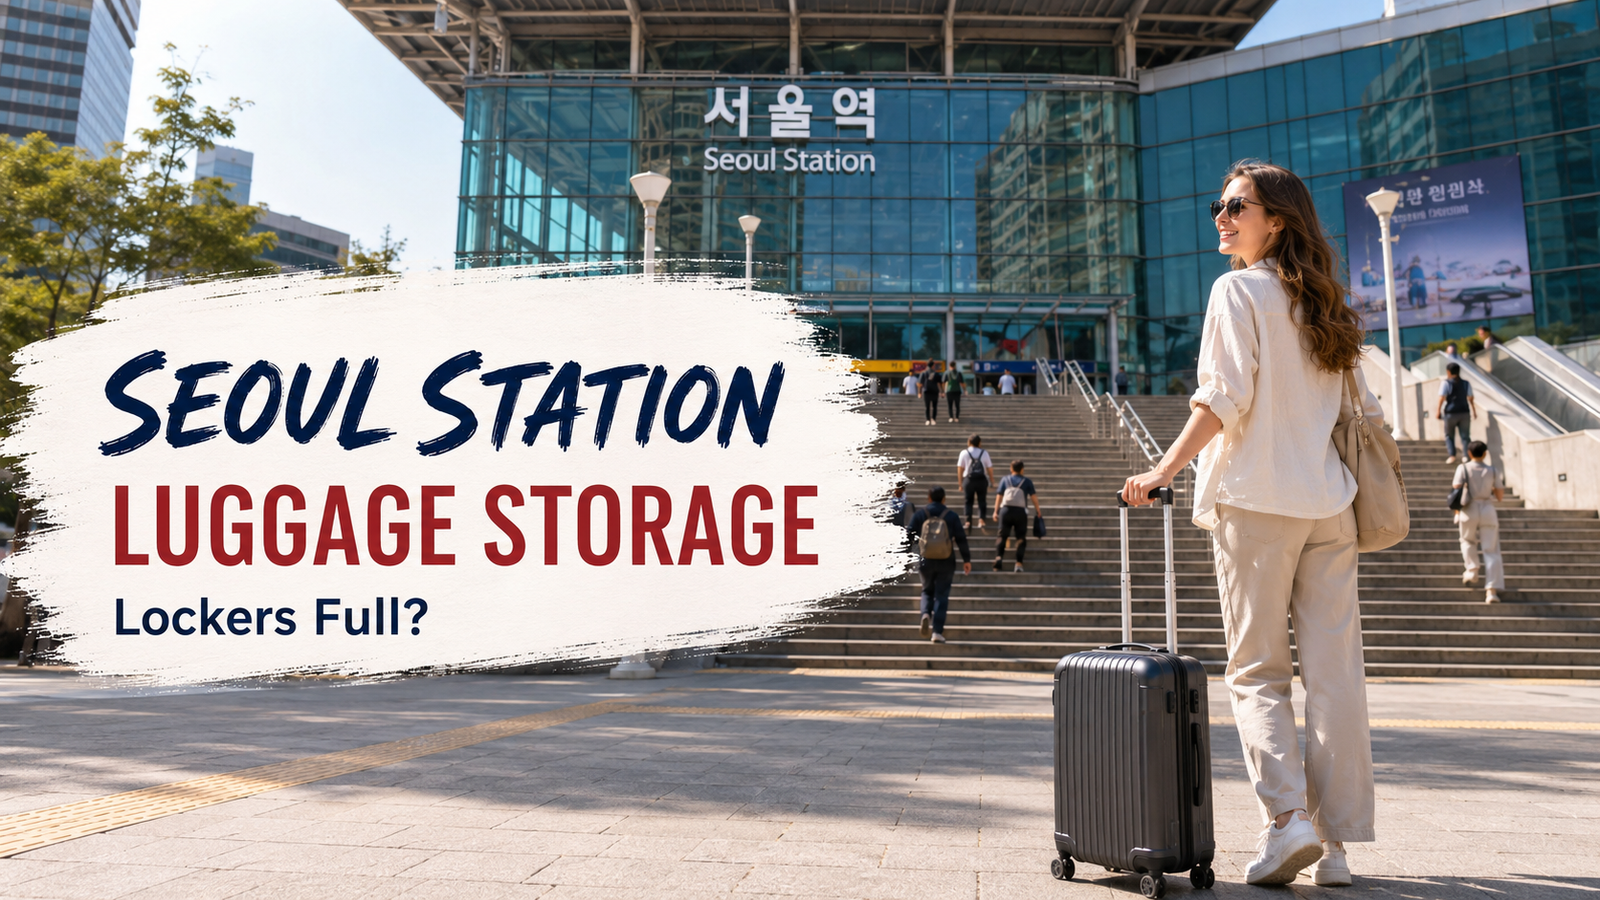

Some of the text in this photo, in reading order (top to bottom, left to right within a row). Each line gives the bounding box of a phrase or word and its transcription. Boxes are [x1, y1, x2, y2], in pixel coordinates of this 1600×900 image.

[703, 84, 875, 139] 서울역
[703, 147, 876, 172] Seoul Station
